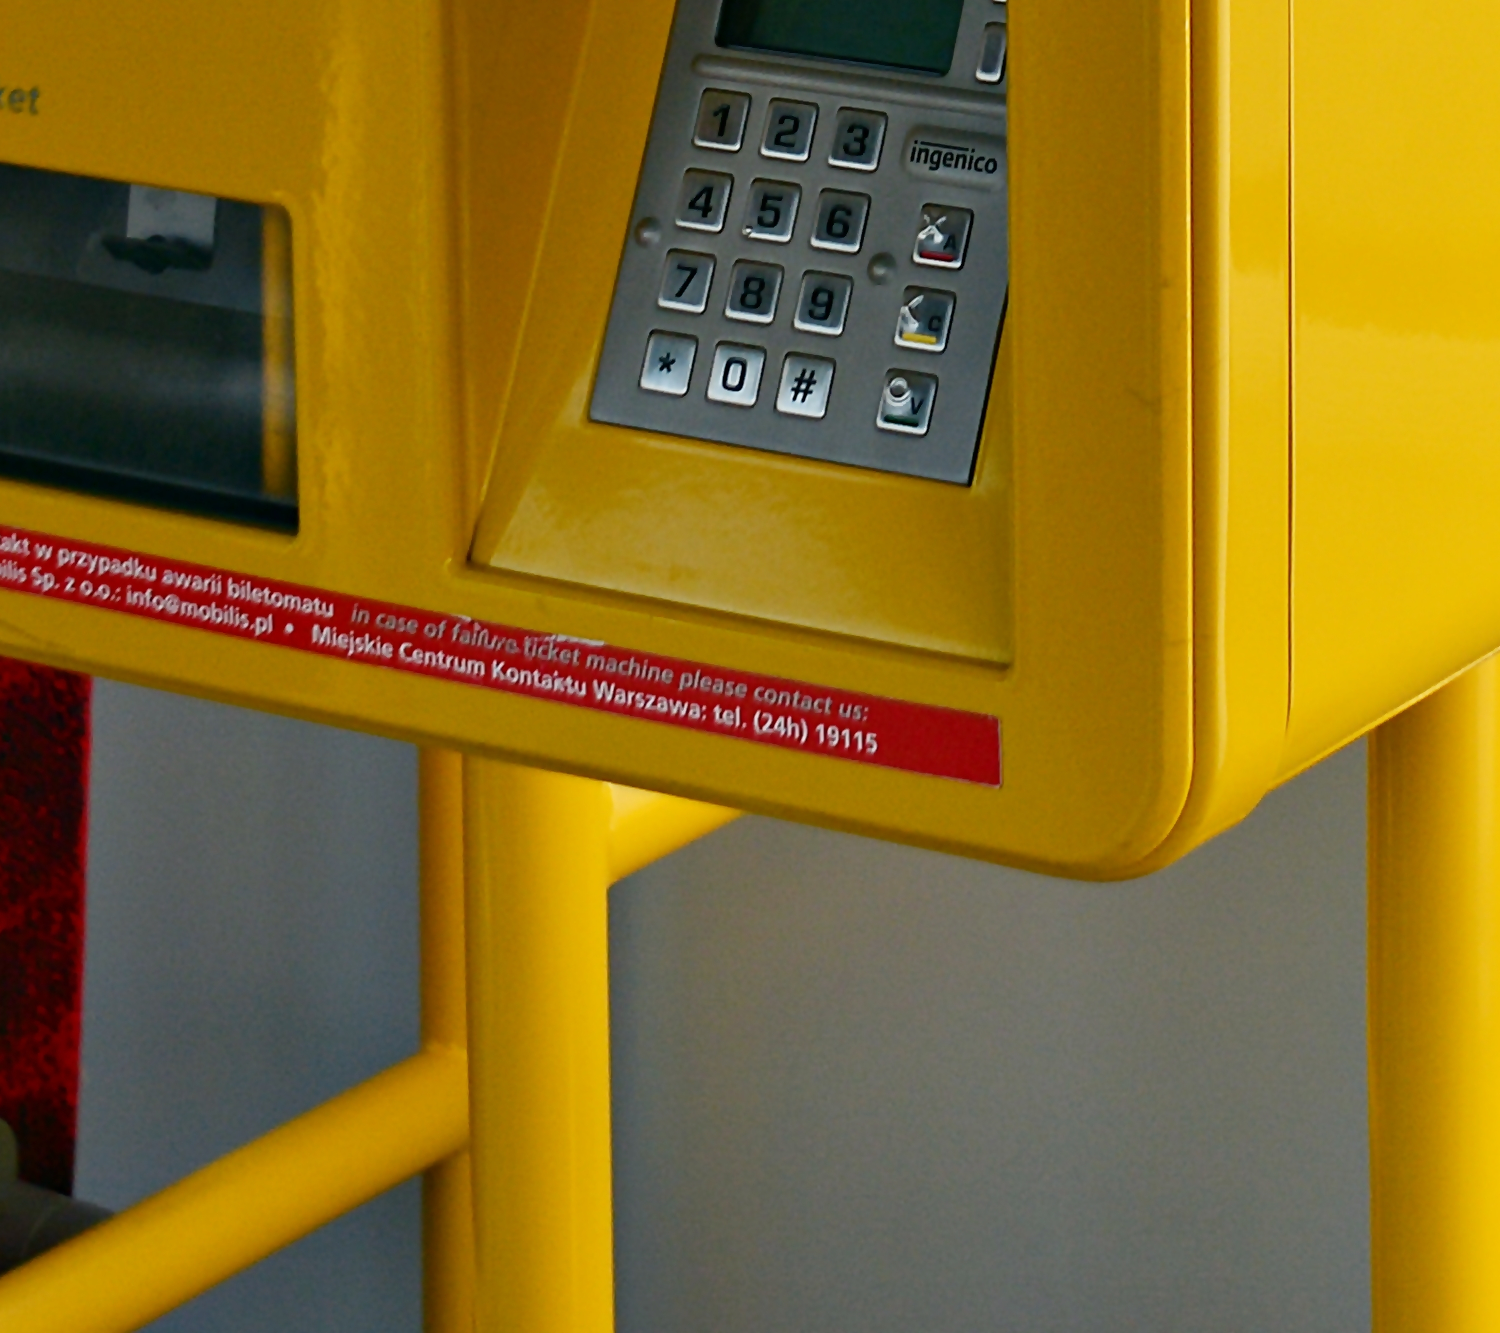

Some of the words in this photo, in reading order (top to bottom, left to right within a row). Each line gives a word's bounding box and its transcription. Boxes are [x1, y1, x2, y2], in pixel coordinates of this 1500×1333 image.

[714, 105, 729, 137] 1
[775, 116, 800, 149] 2
[844, 124, 870, 158] 3
[910, 139, 998, 174] ingenico
[689, 187, 714, 219] 4
[757, 194, 783, 229] 5
[827, 205, 851, 237] 6
[674, 267, 697, 298] 7
[739, 275, 766, 309] 8
[808, 287, 833, 321] 9
[722, 358, 746, 391] 0
[34, 542, 53, 561] w
[57, 547, 157, 582] przypadku
[162, 569, 222, 595] awarii
[227, 577, 334, 618] biletomatu
[351, 603, 370, 624] in
[376, 612, 419, 634] case
[424, 619, 447, 640] of
[523, 635, 581, 666] ticket
[586, 652, 674, 684] machine
[678, 669, 748, 699] please
[754, 686, 832, 715] contact
[31, 566, 60, 593] Sp.
[63, 577, 76, 593] z
[126, 585, 273, 636] info@mobilis.pl
[311, 624, 394, 656] Miejskie
[399, 642, 485, 676] Centrum
[491, 660, 587, 696] Kontaktu
[713, 704, 747, 729] tel.
[753, 709, 808, 744] (24h)
[815, 723, 878, 754] 19115
